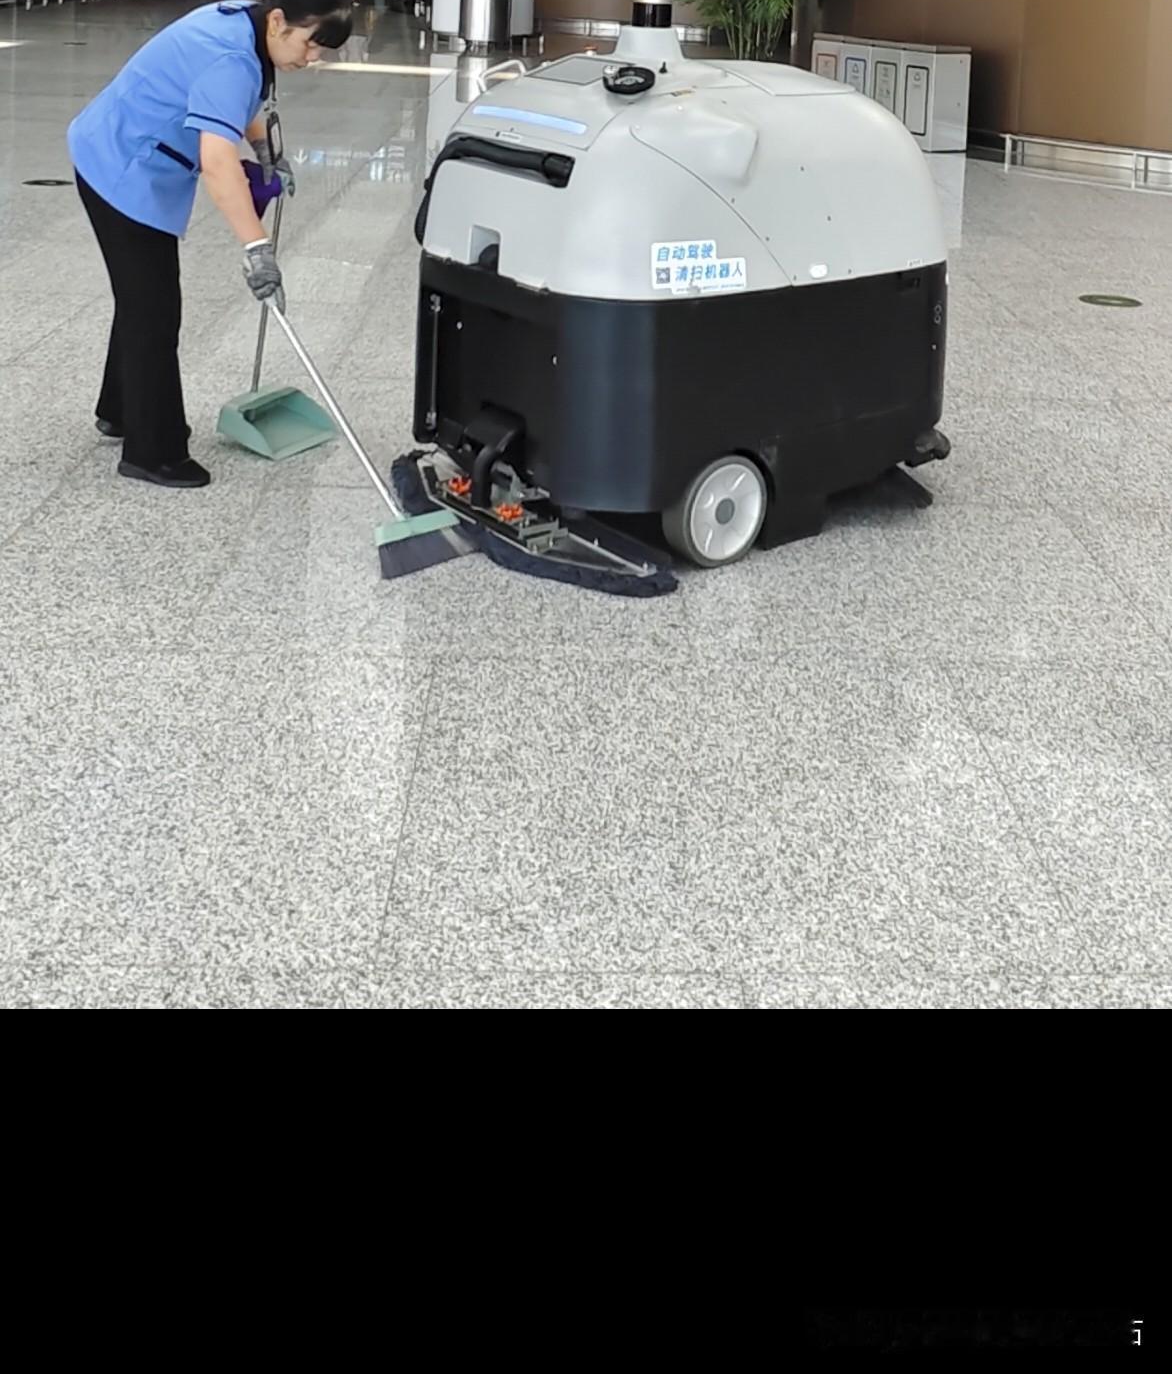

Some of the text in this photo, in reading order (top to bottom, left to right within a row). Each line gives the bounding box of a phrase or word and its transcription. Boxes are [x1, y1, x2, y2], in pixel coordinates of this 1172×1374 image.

[656, 243, 714, 262] 自动驾驶
[675, 261, 743, 282] 清扫机器人
